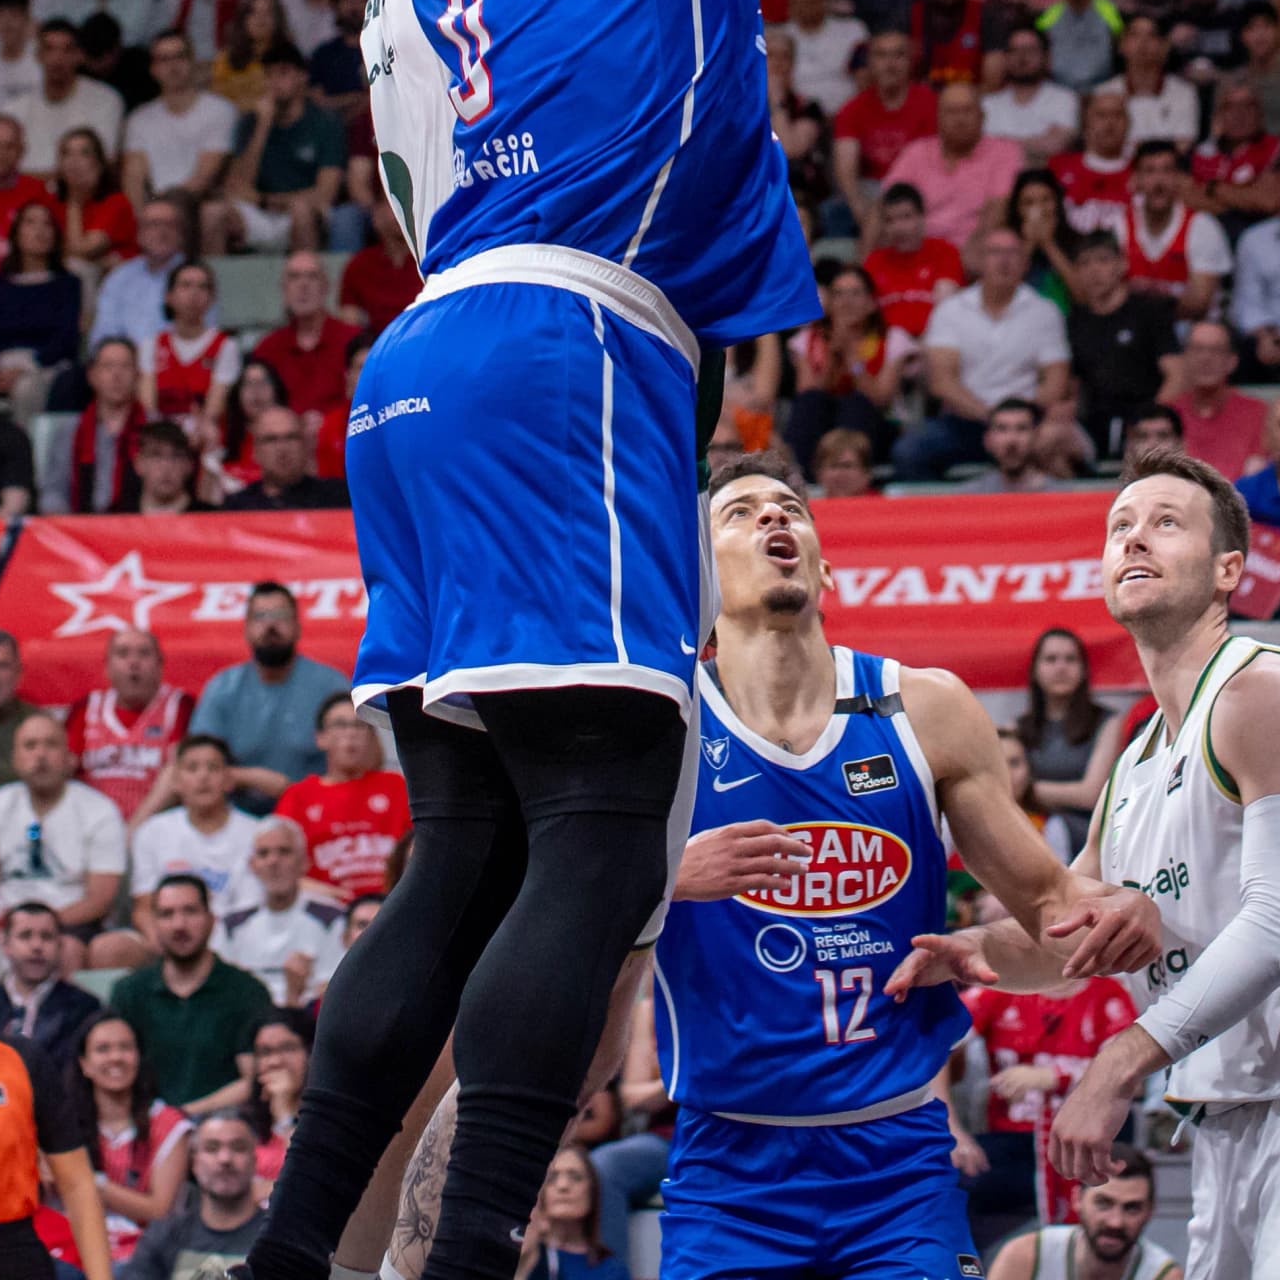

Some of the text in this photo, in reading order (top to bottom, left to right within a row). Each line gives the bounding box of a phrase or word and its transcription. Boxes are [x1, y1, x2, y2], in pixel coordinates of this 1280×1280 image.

[833, 557, 1106, 608] VANTE
[849, 771, 870, 783] liga
[852, 776, 895, 791] endesa
[814, 929, 870, 949] REGIÓN
[817, 940, 895, 962] DE MURCIA
[813, 965, 877, 1046] 12
